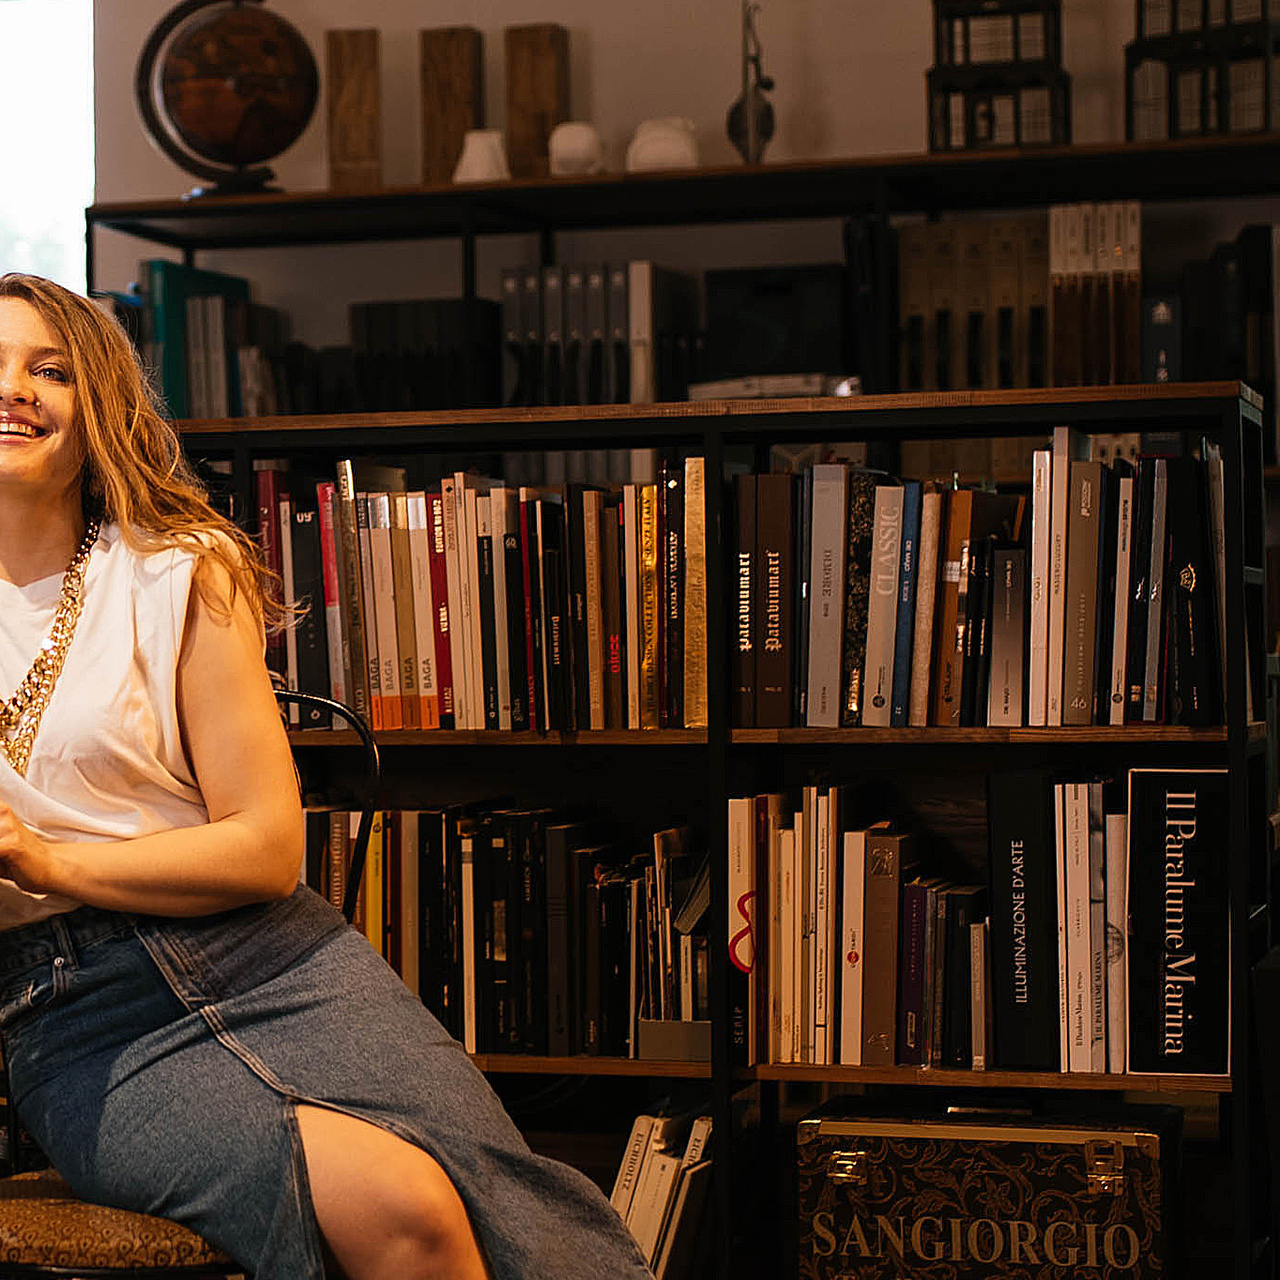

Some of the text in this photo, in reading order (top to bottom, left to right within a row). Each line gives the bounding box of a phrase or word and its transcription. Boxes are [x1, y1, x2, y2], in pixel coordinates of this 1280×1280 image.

[876, 505, 900, 596] CLASSIC
[737, 551, 753, 653] Pataviumart
[764, 549, 784, 653] Pataviumart
[370, 657, 380, 689] BAGA
[384, 659, 394, 690] BAGA
[404, 657, 414, 689] BAGA
[422, 658, 432, 689] BAGA
[1010, 839, 1028, 1004] ILLUMINAZIONE D'ARTE
[1165, 815, 1198, 950] Paralume
[1165, 952, 1198, 1056] Marina
[812, 1211, 1140, 1270] SANGIORGIO
